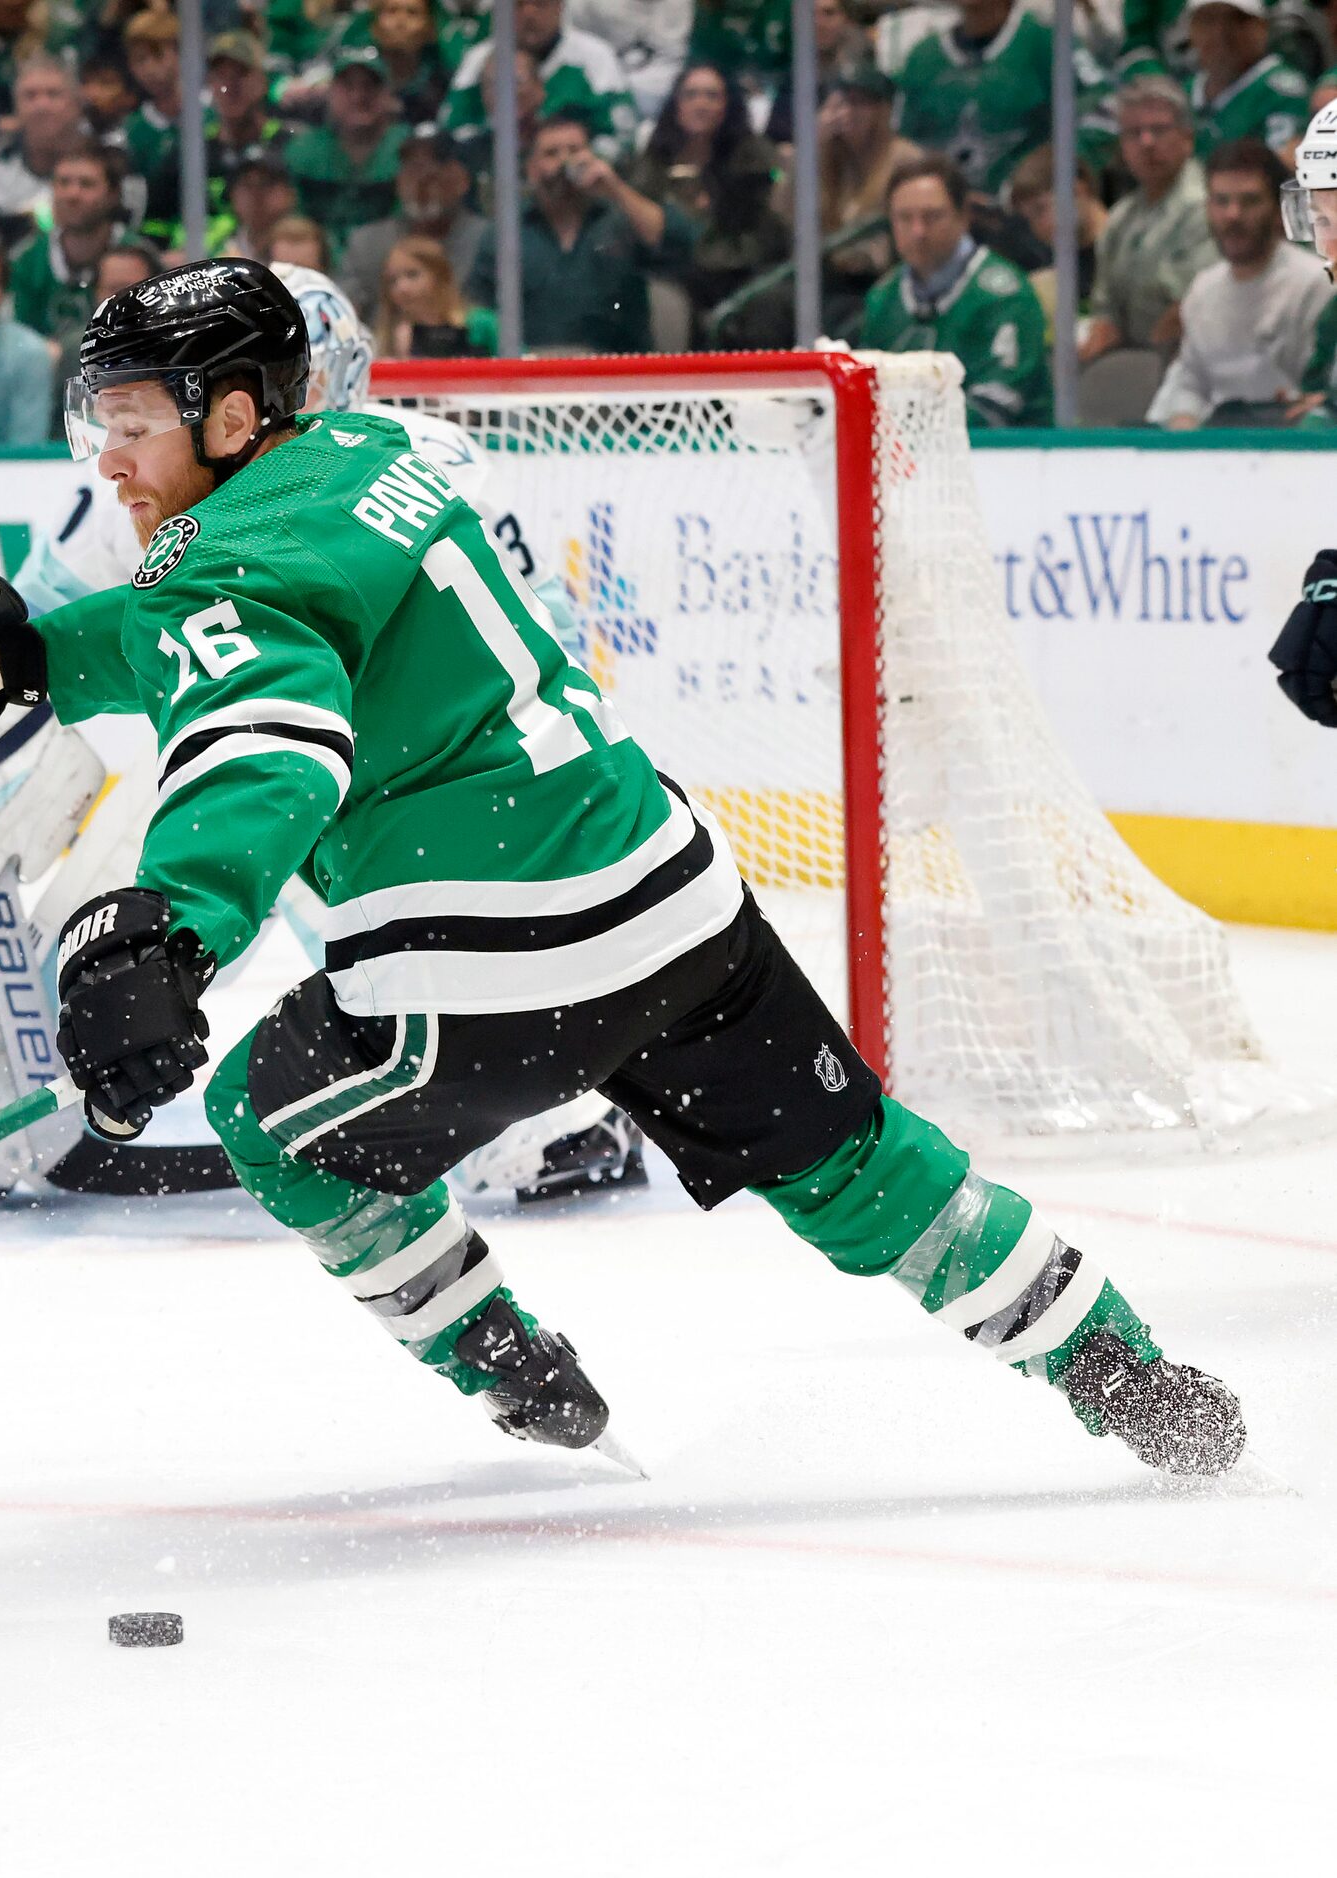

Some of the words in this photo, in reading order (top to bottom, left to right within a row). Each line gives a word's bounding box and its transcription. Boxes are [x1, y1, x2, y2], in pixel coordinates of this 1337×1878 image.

[159, 268, 208, 289] ENERGY
[163, 275, 229, 299] TRANSFER
[352, 452, 460, 550] PAVE
[157, 599, 262, 708] 16
[23, 688, 40, 703] 16
